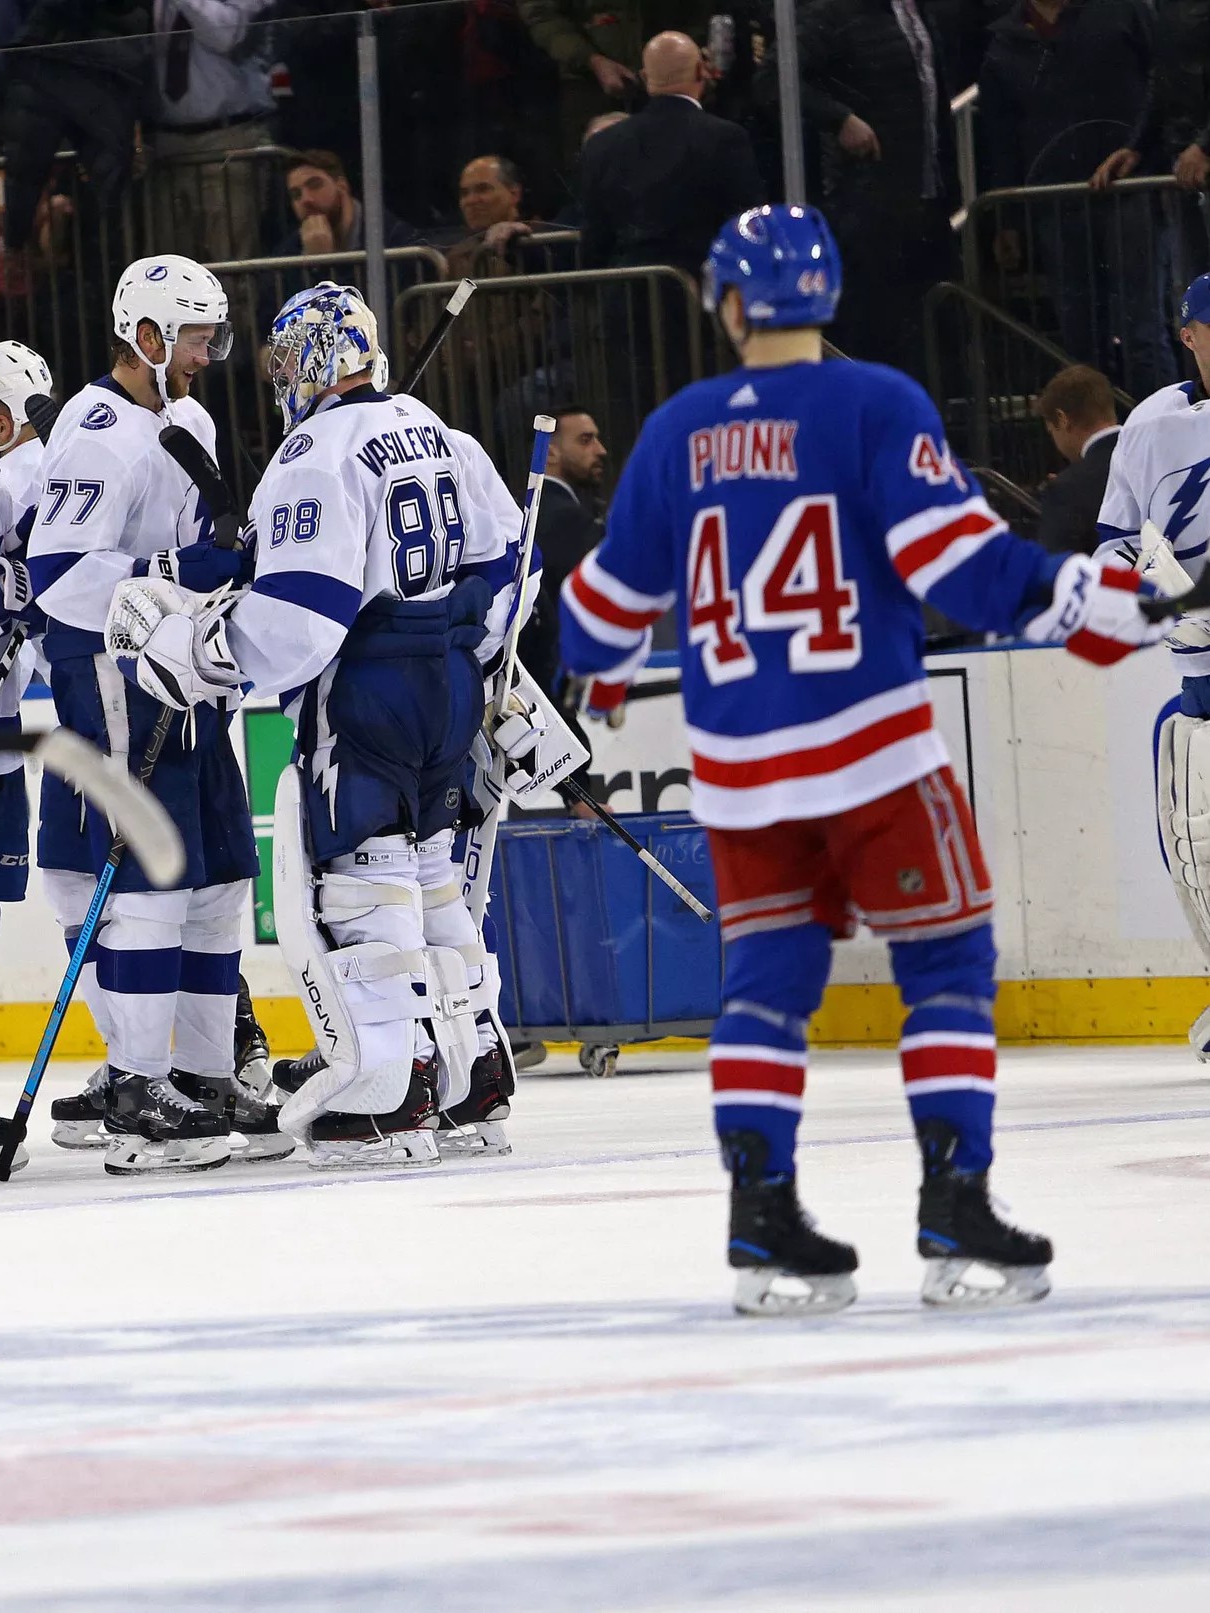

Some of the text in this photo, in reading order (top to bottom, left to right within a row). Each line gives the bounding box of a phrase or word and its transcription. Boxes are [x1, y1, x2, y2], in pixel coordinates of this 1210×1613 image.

[688, 419, 799, 492] PIONK
[42, 479, 105, 526] 77
[270, 498, 322, 549] 88
[385, 471, 467, 601] 88
[687, 494, 863, 687] 44
[301, 959, 338, 1053] VAPOR
